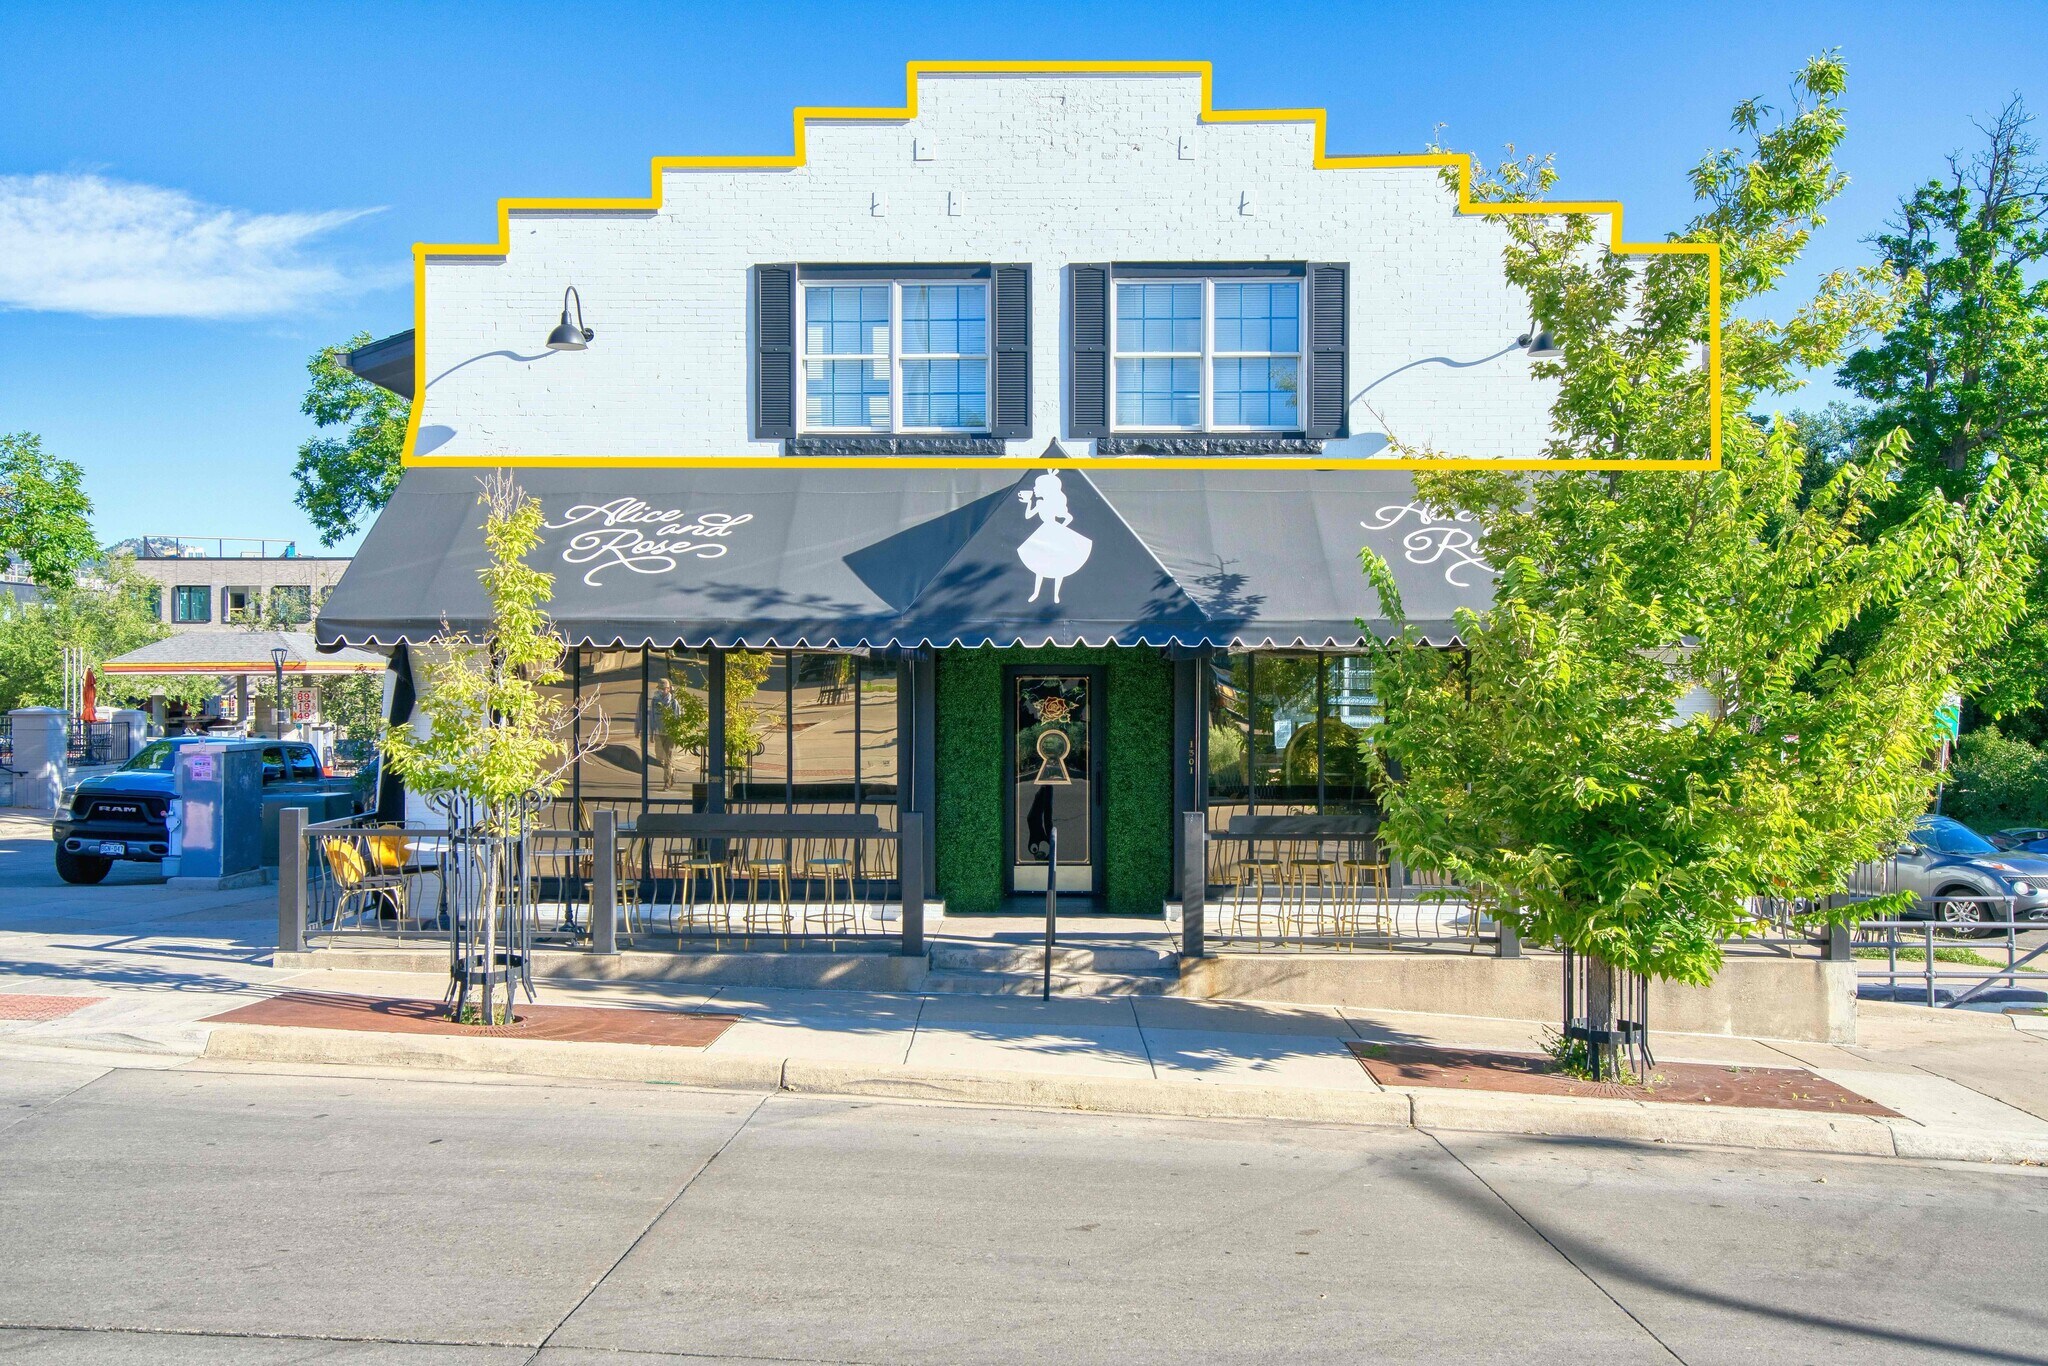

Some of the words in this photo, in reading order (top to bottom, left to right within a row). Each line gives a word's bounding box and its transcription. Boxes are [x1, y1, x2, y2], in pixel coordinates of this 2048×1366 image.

[543, 497, 684, 530] Alice
[656, 513, 754, 537] and
[562, 528, 727, 587] Rose
[98, 805, 137, 813] RAM
